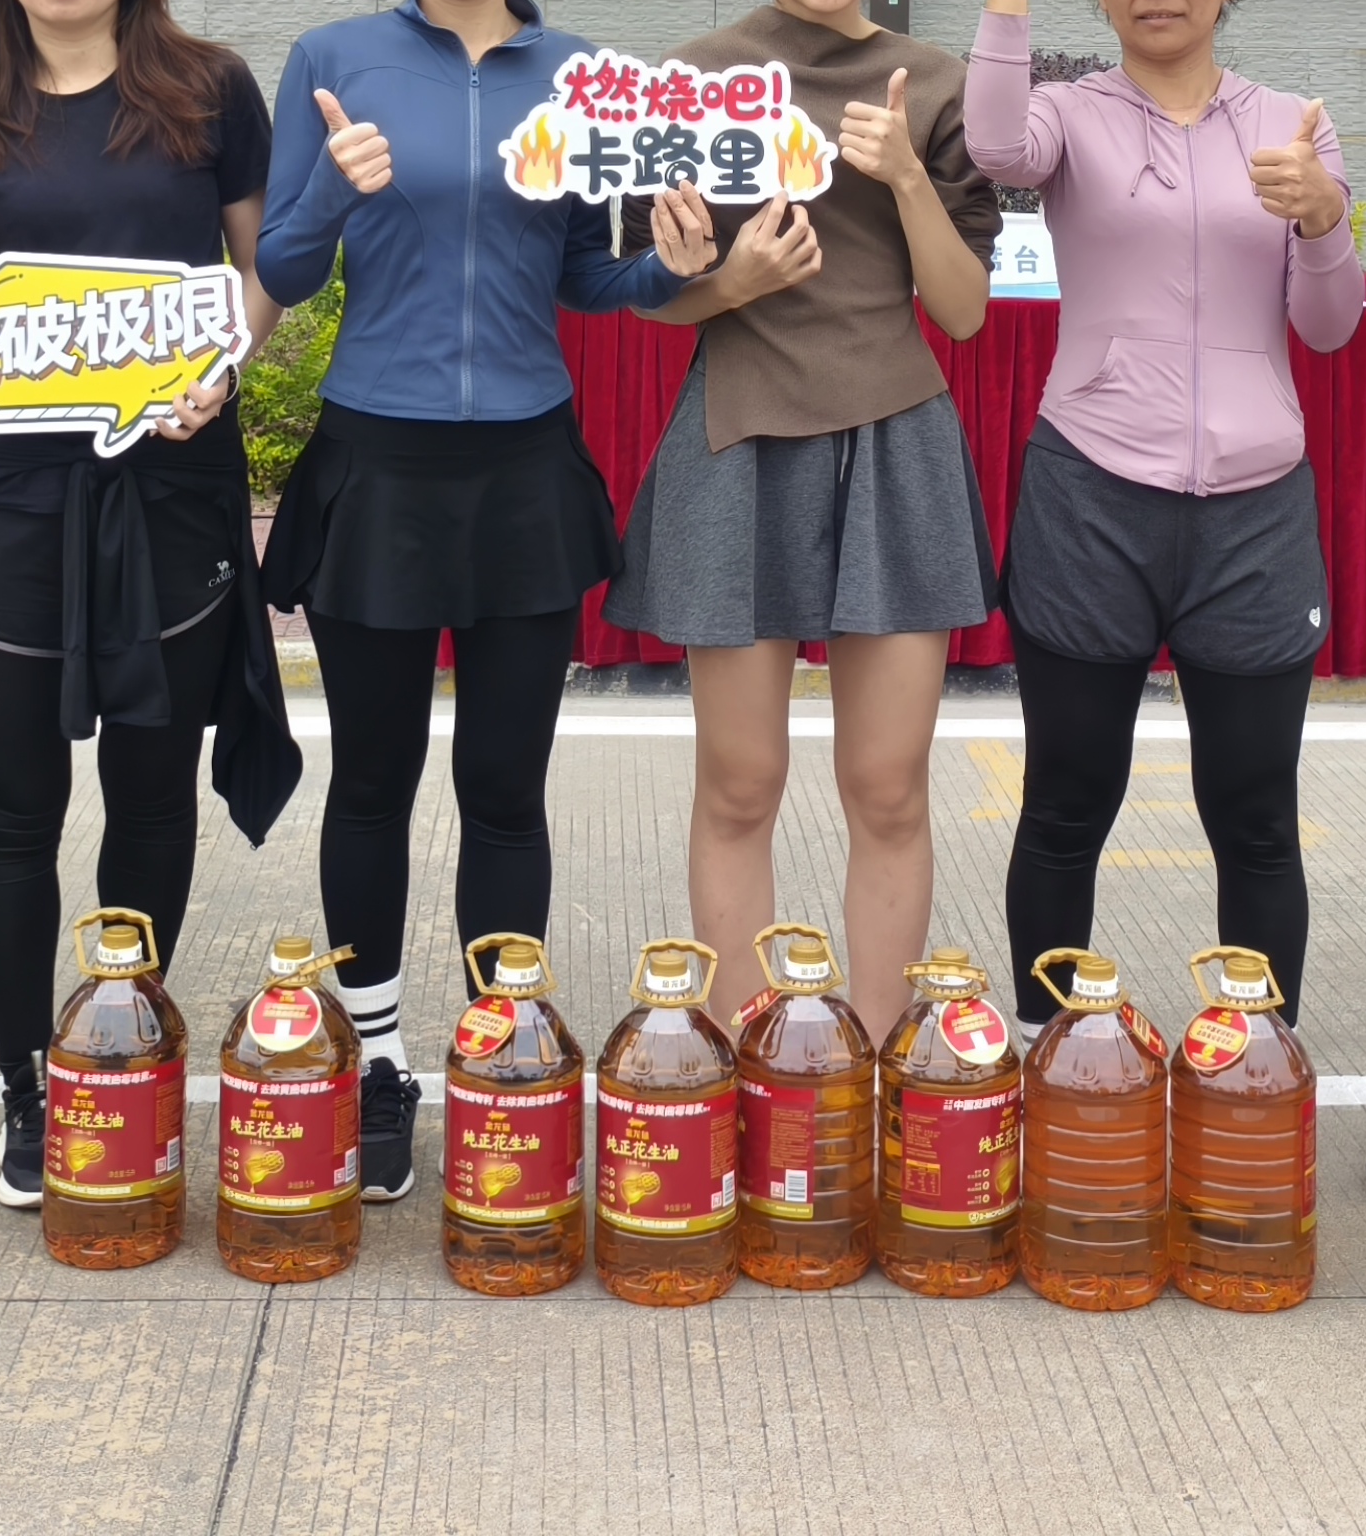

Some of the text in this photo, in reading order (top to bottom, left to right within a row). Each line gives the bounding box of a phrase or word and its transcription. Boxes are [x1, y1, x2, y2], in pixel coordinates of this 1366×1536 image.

[569, 123, 765, 195] 卡路里
[54, 1105, 124, 1128] 纯正花生油
[230, 1116, 304, 1138] 纯正花生油
[463, 1129, 540, 1151] 纯正花生油
[606, 1134, 679, 1160] 纯正花生油
